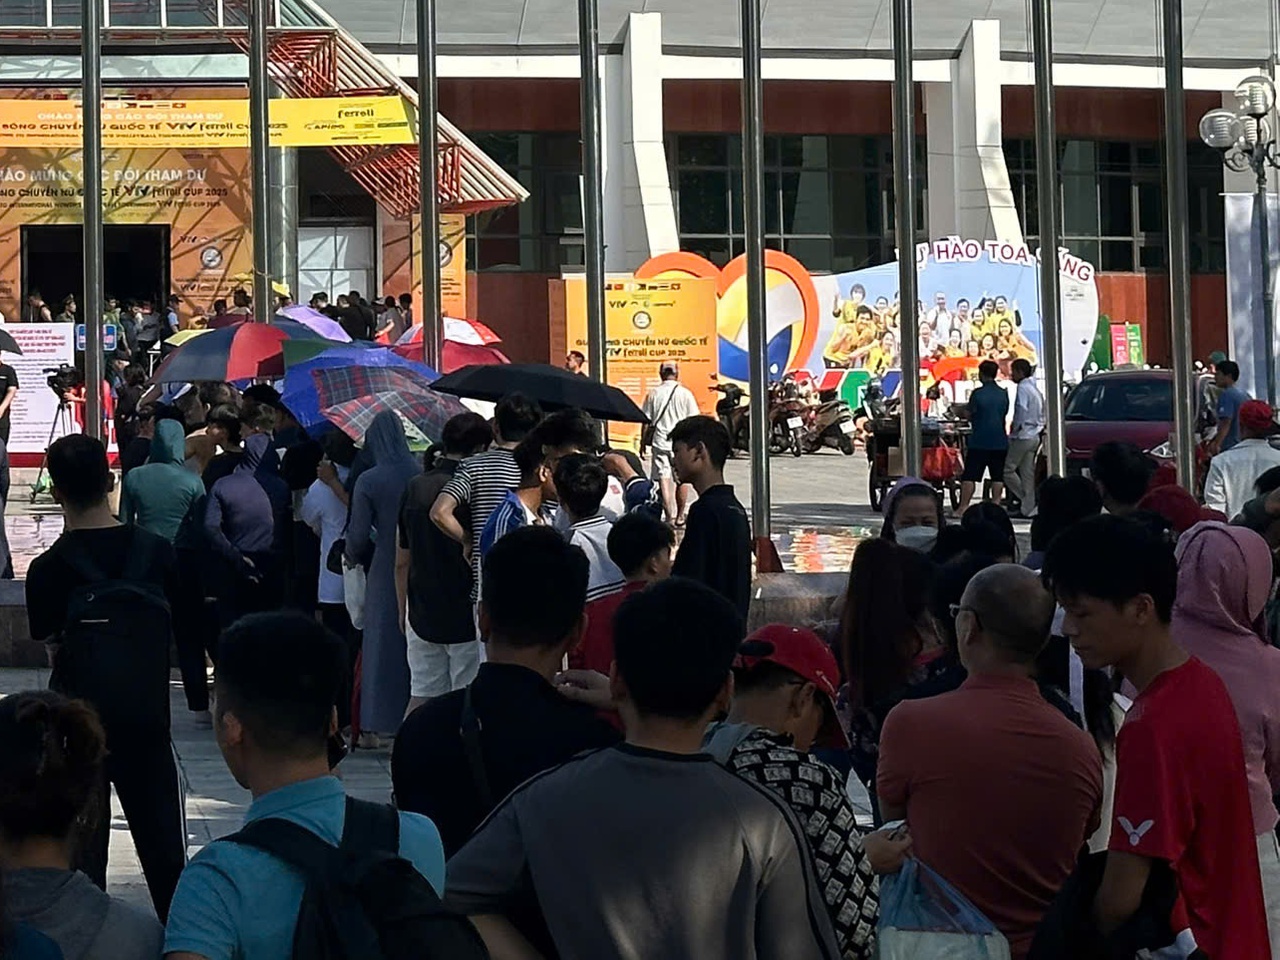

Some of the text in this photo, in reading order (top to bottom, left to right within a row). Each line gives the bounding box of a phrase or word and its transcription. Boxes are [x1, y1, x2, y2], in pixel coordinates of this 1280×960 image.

[166, 121, 198, 131] VTV
[142, 170, 183, 181] THAM
[124, 185, 150, 197] VTV
[183, 188, 203, 197] CUP
[205, 188, 228, 197] 2025
[936, 237, 979, 260] HÀO
[608, 300, 627, 308] VTV
